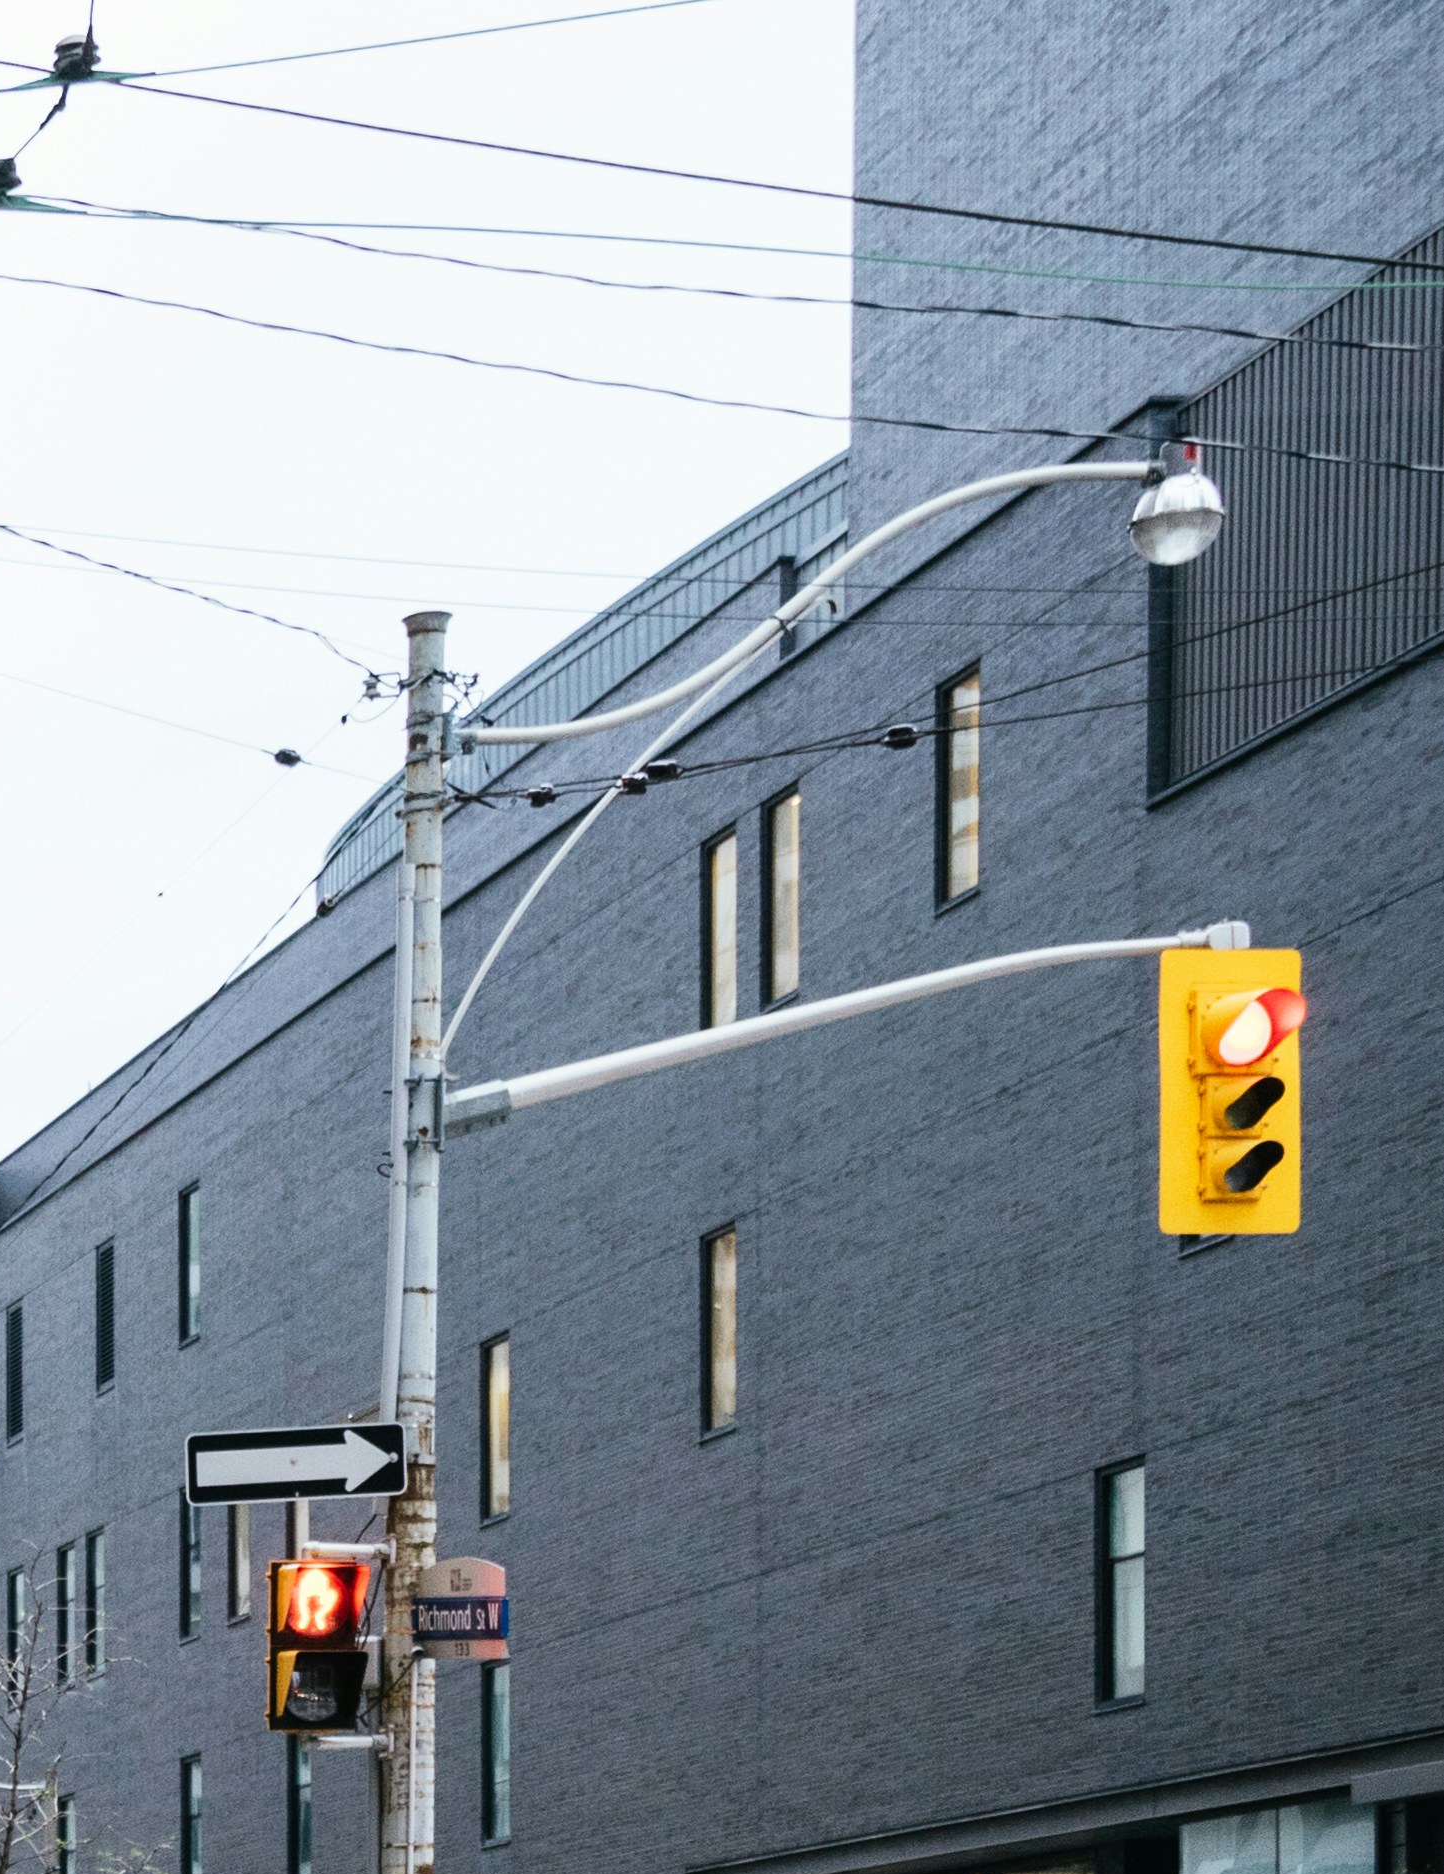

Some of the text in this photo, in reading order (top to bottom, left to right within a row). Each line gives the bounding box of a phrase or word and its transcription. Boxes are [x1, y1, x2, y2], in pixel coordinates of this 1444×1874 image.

[419, 1603, 499, 1631] Richmond St W
